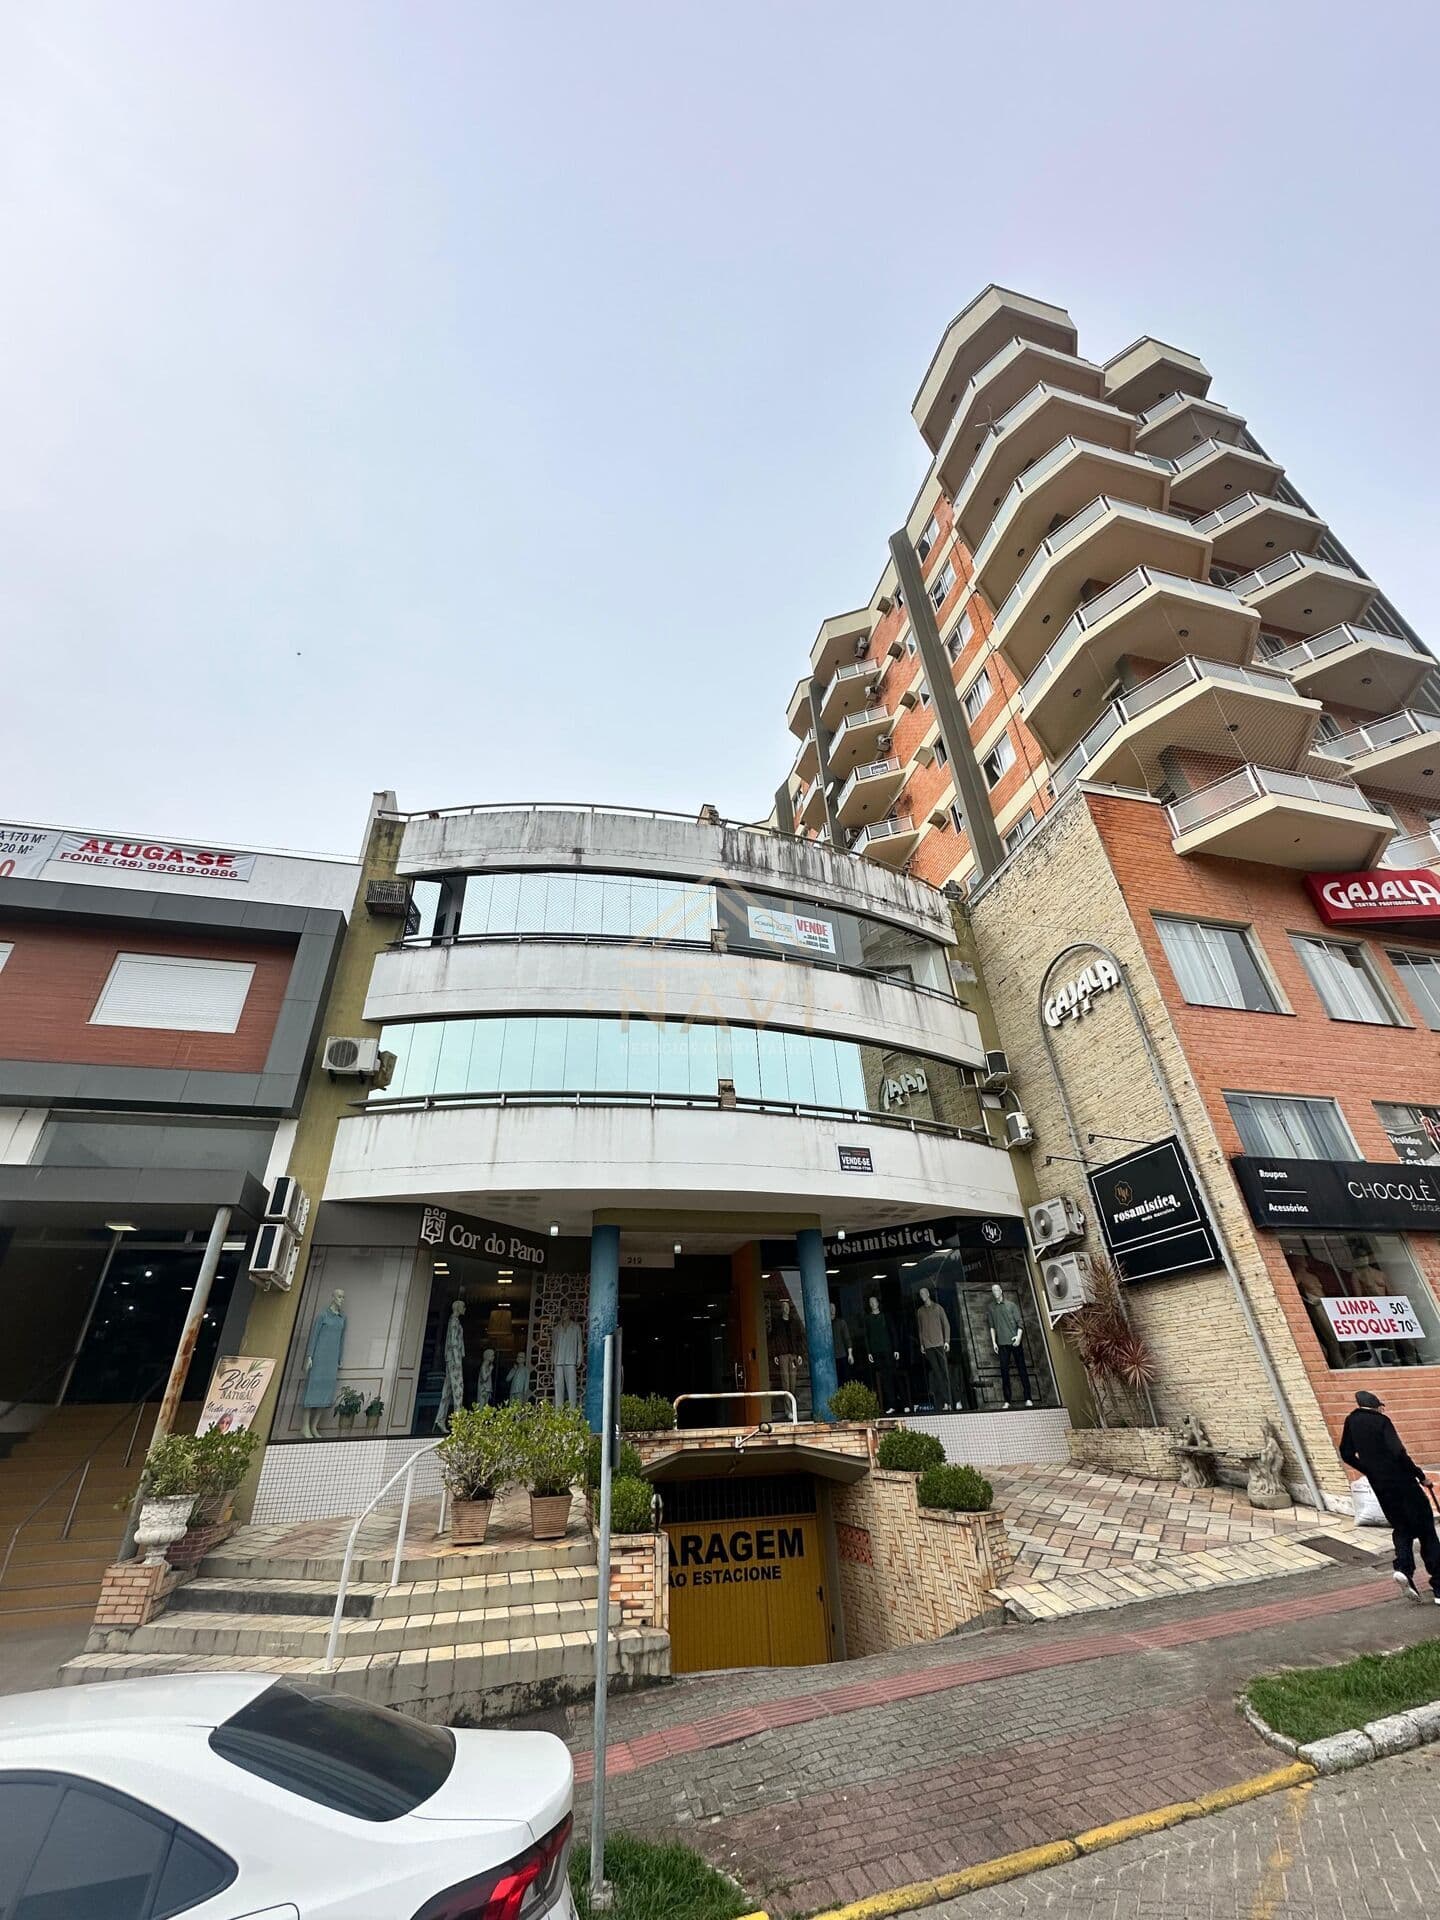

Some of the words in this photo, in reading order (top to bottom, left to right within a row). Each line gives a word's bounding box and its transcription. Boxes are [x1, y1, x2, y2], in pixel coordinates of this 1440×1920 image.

[78, 837, 236, 868] ALUGA-SE
[60, 852, 109, 865] FONE:
[112, 859, 143, 869] (48)
[147, 862, 238, 878] 99619-0886
[1322, 879, 1440, 909] GAJALA
[796, 919, 829, 936] VENDE
[1044, 960, 1120, 1027] GAJALA
[841, 1155, 871, 1166] VENDE-SE
[1258, 1169, 1288, 1179] Roupas
[1347, 1178, 1436, 1202] CHOCOLÊ
[1269, 1203, 1309, 1213] Acessórios
[449, 1224, 481, 1250] Cor
[484, 1232, 506, 1255] do
[508, 1238, 545, 1264] Pano
[823, 1227, 943, 1258] rosamística
[1336, 1300, 1380, 1315] LIMPA
[1333, 1319, 1399, 1335] ESTOQUE
[218, 1369, 264, 1391] Broto
[692, 1565, 782, 1586] ESTACIONE
